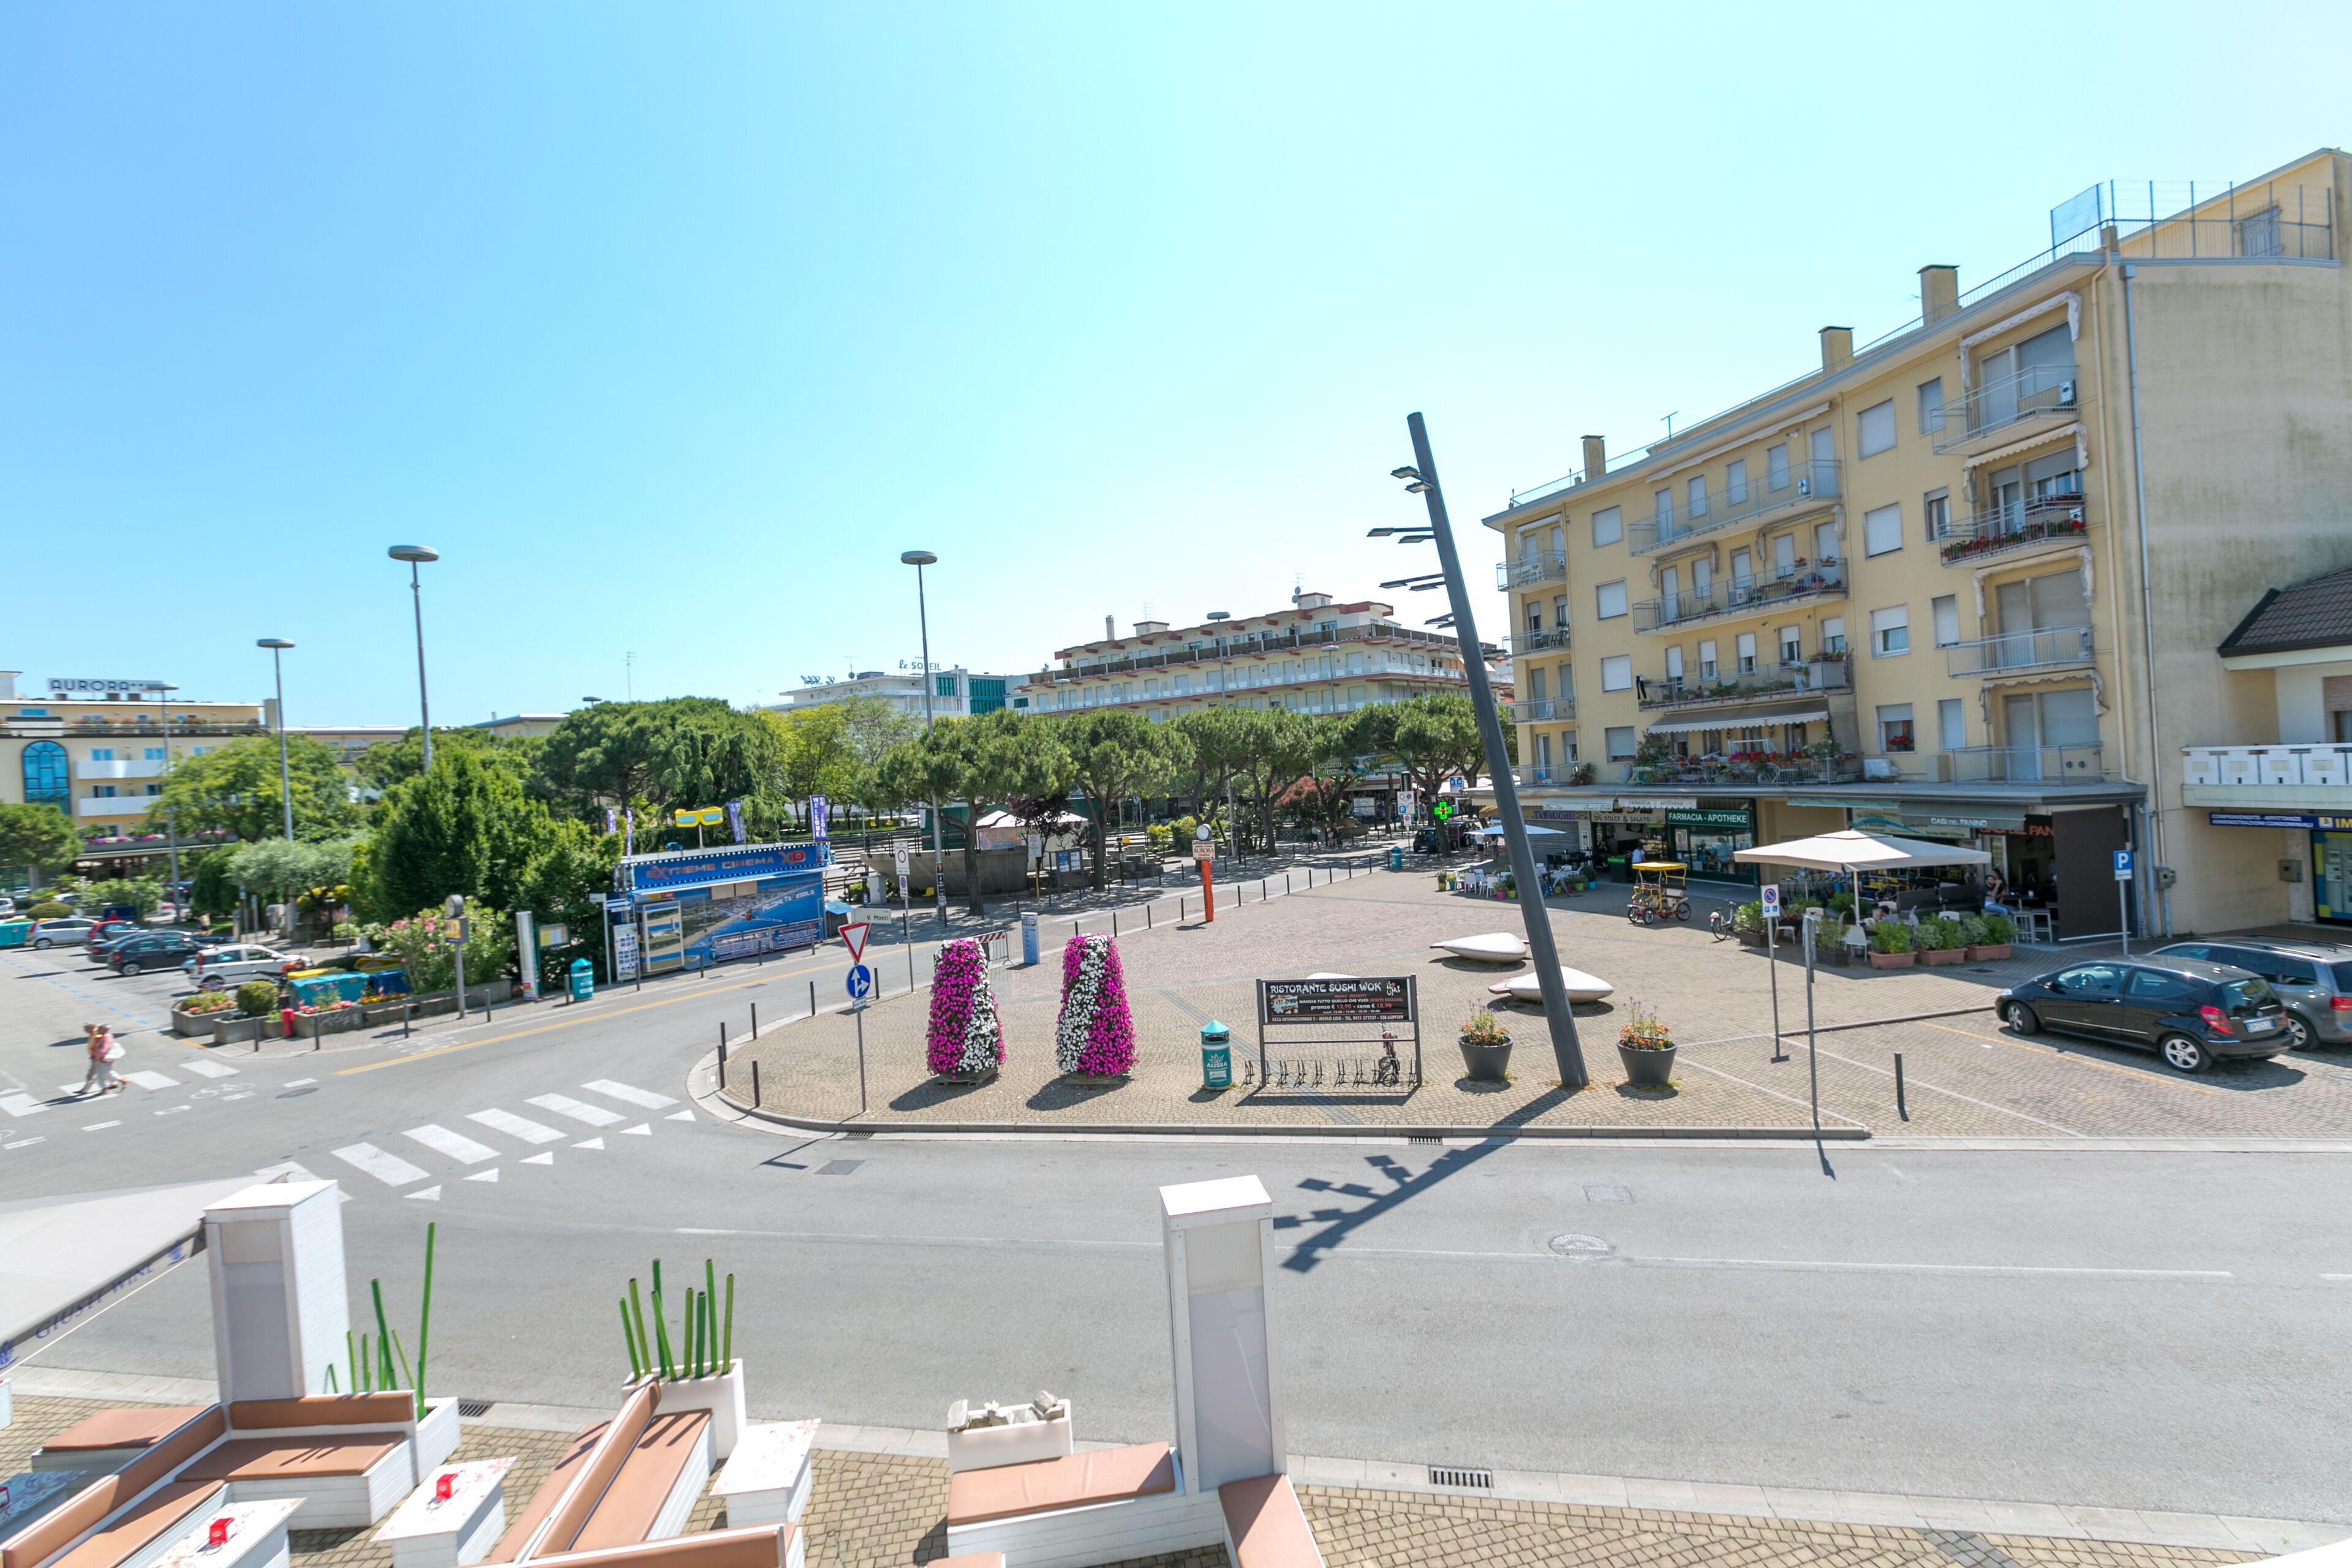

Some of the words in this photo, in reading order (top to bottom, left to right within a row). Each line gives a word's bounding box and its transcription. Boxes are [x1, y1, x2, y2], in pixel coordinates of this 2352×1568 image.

[911, 662, 942, 671] SOEIL
[51, 680, 129, 691] AURORA
[1668, 813, 1703, 821] FARMACIA
[1708, 814, 1747, 823] APOTHEKE
[722, 856, 774, 870] CINEMA
[778, 850, 806, 865] XD
[2118, 853, 2129, 868] P
[1270, 983, 1327, 994] RISTORANTE
[1329, 982, 1357, 993] SUSHI
[1359, 981, 1382, 992] WOK
[35, 1288, 105, 1340] GIUSTI
[111, 1262, 155, 1294] WINE
